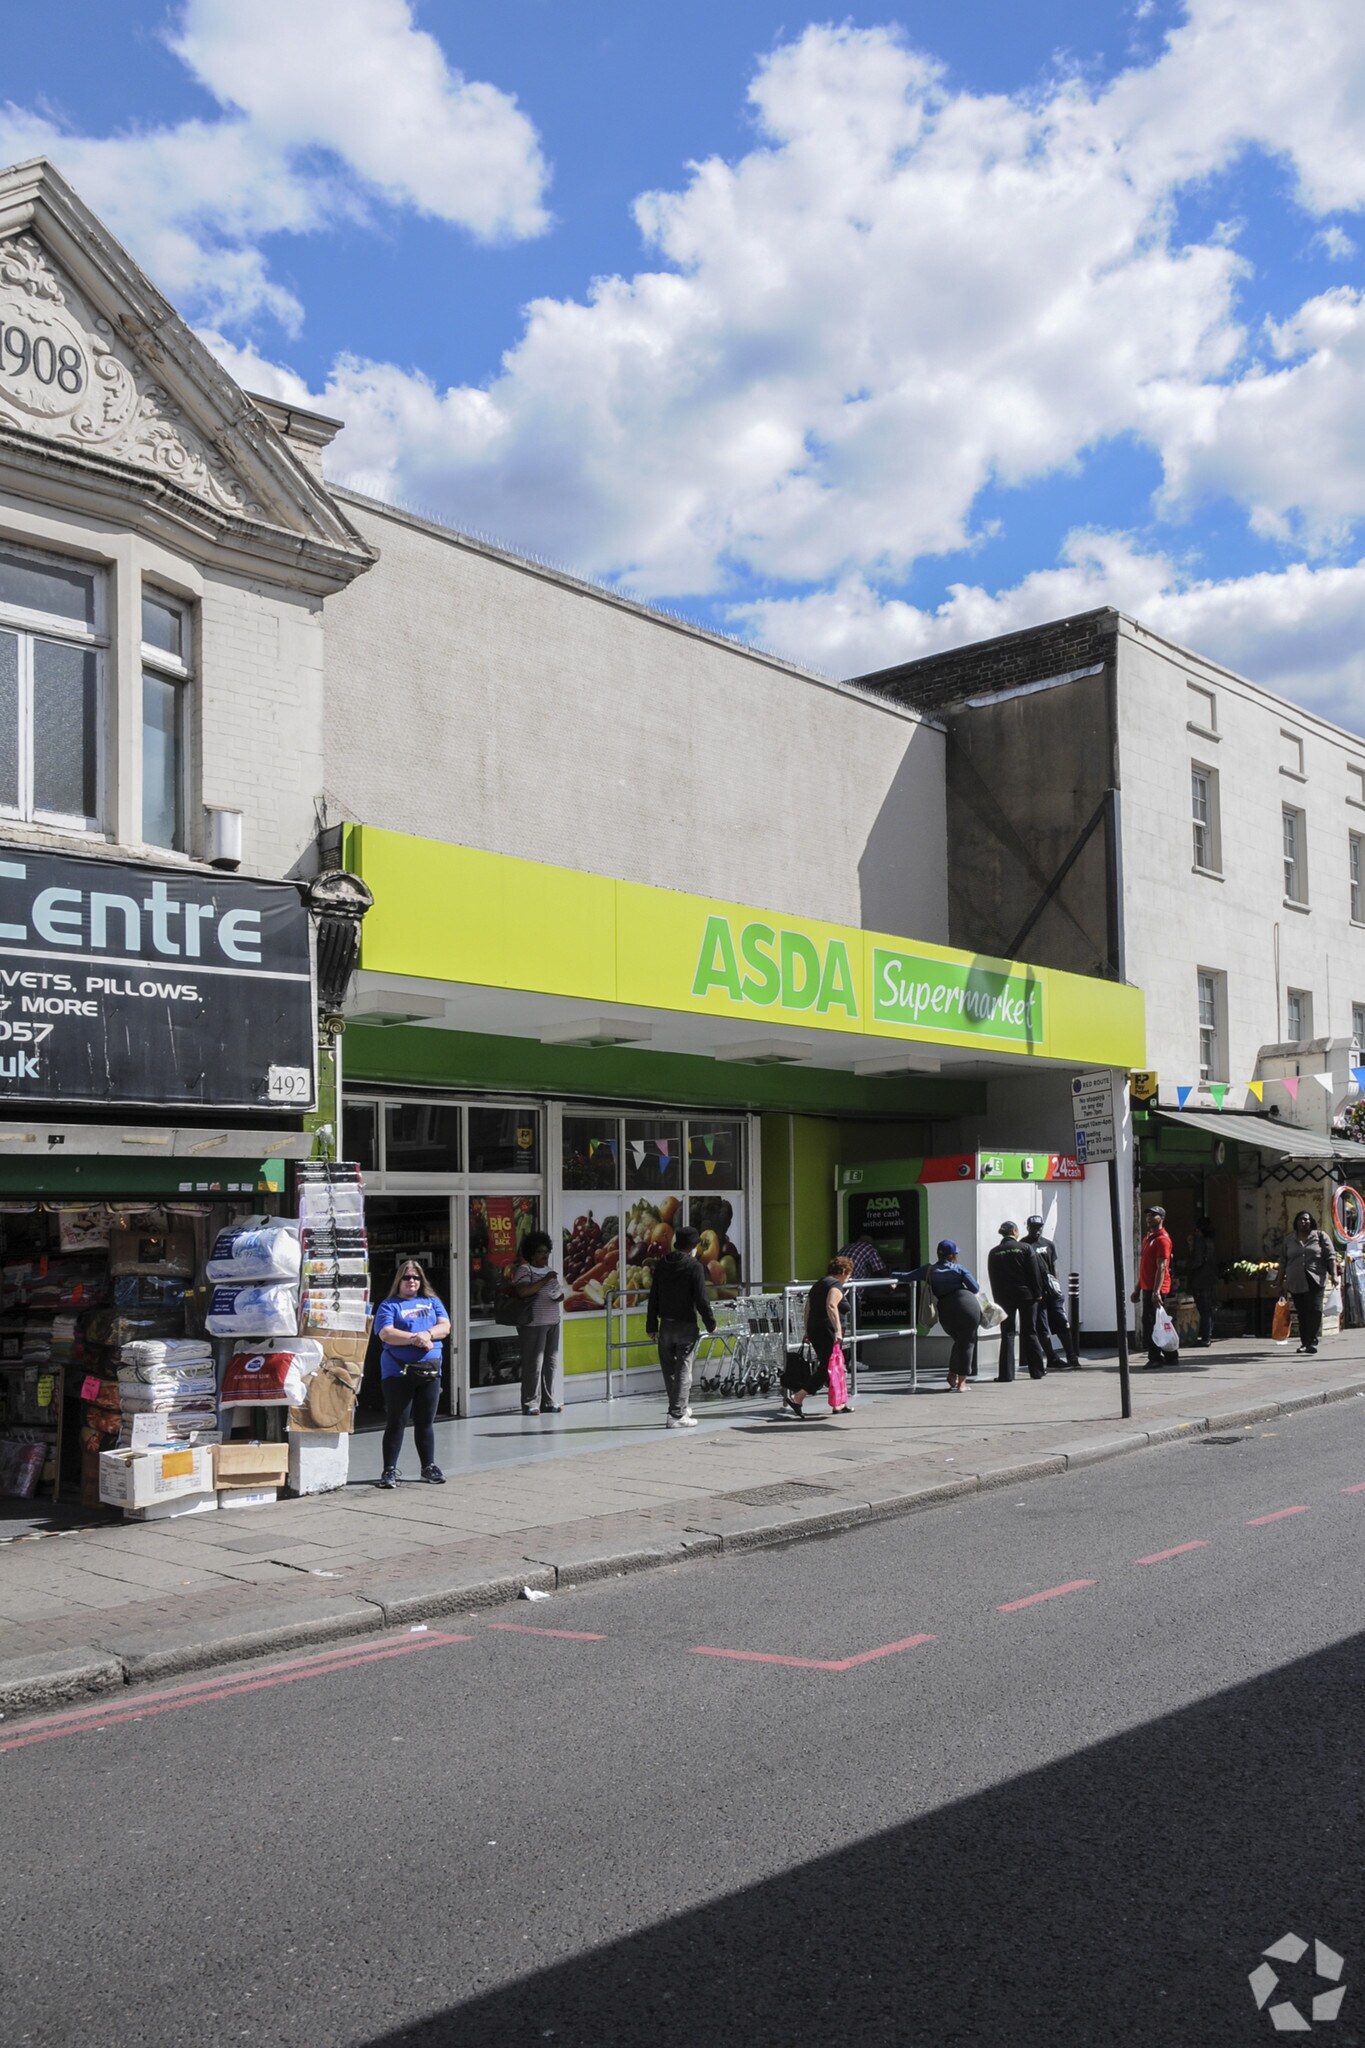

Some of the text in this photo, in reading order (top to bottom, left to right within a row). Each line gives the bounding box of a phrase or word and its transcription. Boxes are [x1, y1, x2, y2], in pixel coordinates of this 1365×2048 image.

[691, 915, 859, 1019] ASDA
[0, 969, 203, 1003] VETS, PILLOWS,
[879, 959, 1035, 1029] Supermarket
[22, 995, 98, 1018] MORE
[0, 1020, 54, 1043] 057
[0, 1050, 40, 1078] uk
[271, 1075, 306, 1096] 492
[1082, 1077, 1110, 1088] RED ROUTE
[1086, 1094, 1105, 1104] stopping
[1096, 1101, 1104, 1109] day
[1075, 1121, 1090, 1130] Except
[1052, 1157, 1077, 1177] 24 hou
[1068, 1167, 1082, 1177] cash
[866, 1197, 900, 1210] ASDA
[867, 1210, 900, 1219] free cash
[489, 1216, 512, 1231] BIG
[863, 1219, 905, 1228] withdrawals
[495, 1238, 511, 1246] BACK
[877, 1308, 907, 1317] Machine
